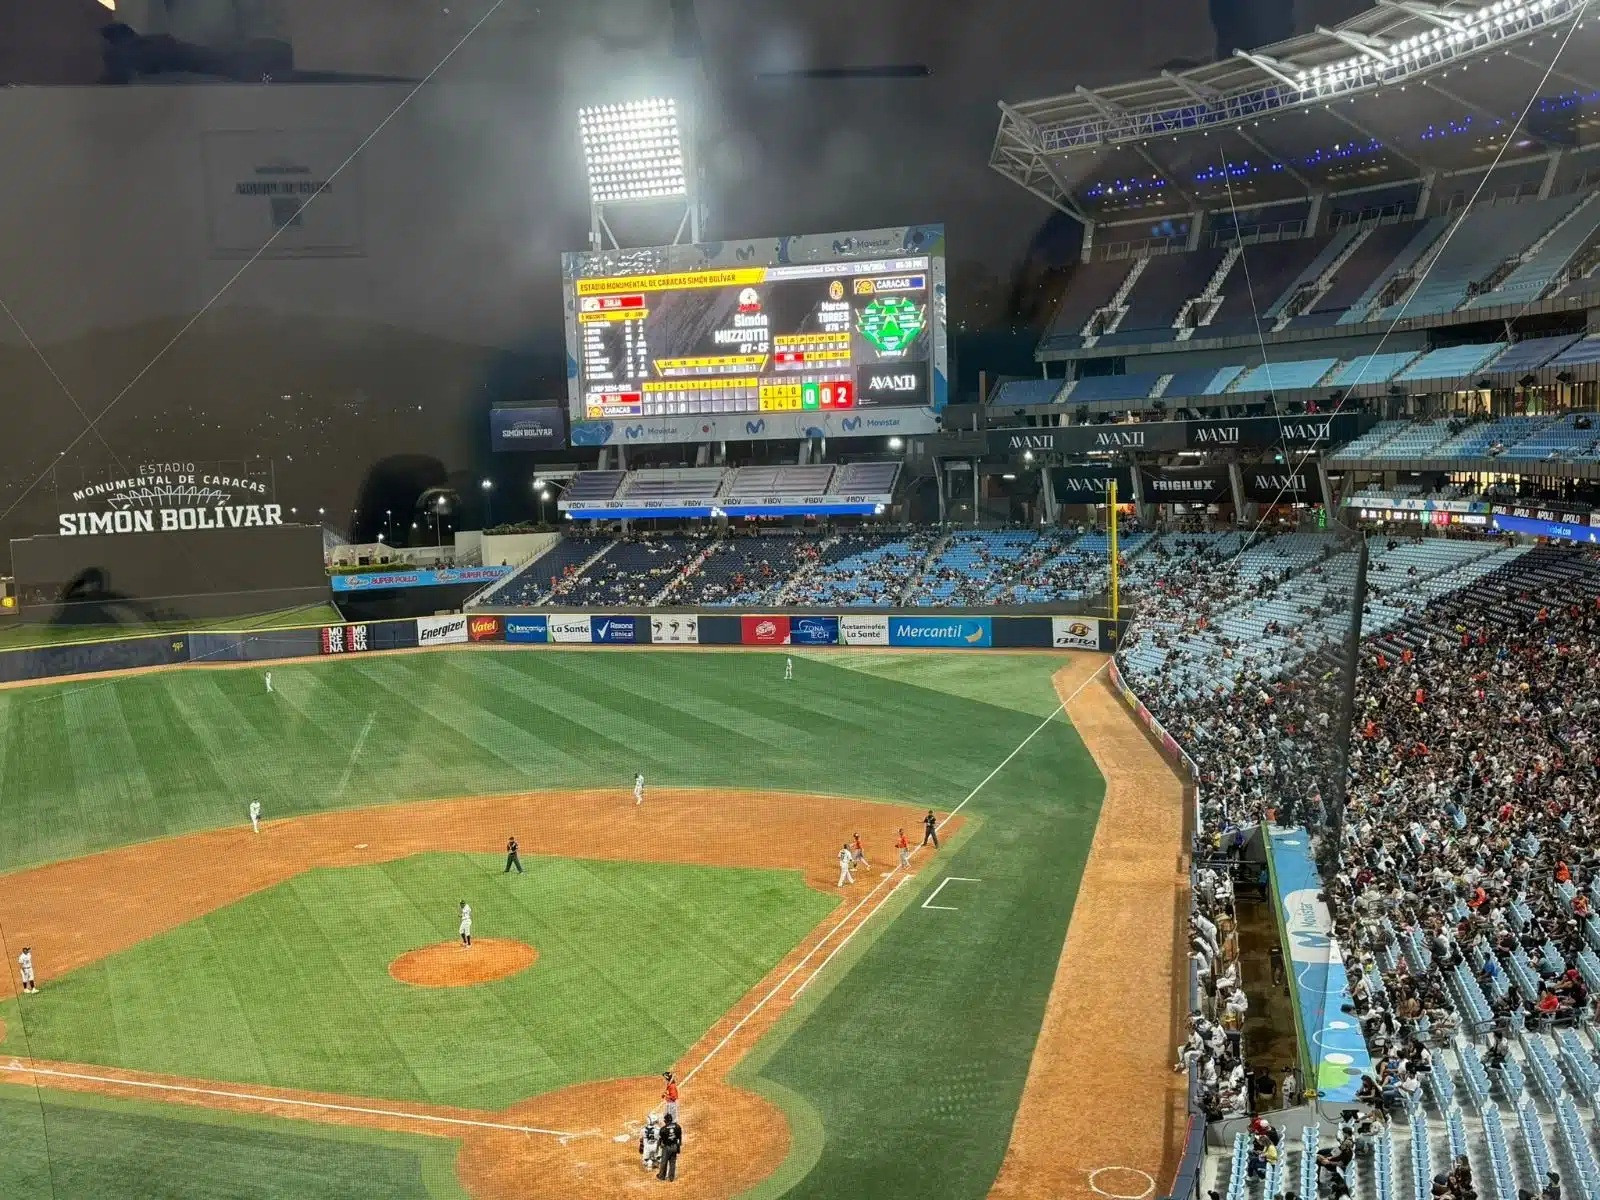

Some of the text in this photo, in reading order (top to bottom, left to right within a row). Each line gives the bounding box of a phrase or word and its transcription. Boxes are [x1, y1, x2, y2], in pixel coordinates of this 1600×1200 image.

[857, 238, 890, 249] Movistar
[580, 273, 736, 292] ESTADIO MONUMENTAL DE CARACAS SIMÓN BOLÍVAR
[876, 279, 910, 289] CARACAS
[734, 312, 768, 328] Simón
[714, 328, 768, 344] MUZZIOTTI
[758, 342, 769, 353] CF
[868, 374, 916, 390] AVANTI
[805, 387, 848, 404] 0 0 2
[604, 405, 631, 414] CARACAS
[866, 418, 900, 429] Movistar
[648, 426, 677, 436] Movistar
[1195, 427, 1239, 442] AVANTI
[1281, 423, 1330, 439] AVANTI
[1008, 435, 1054, 449] AVANTI
[1096, 431, 1145, 446] AVANTI
[139, 462, 195, 475] ESTADIO
[72, 474, 267, 501] MONUMENTAL DE CARACAS
[1152, 479, 1213, 491] FRIGILUX
[1254, 474, 1307, 490] AVANTI
[1492, 505, 1506, 515] APOLO
[1513, 507, 1530, 518] APOLO
[1537, 510, 1554, 521] APOLO
[58, 500, 283, 536] SIMÓN BOLÍVAR
[1562, 513, 1580, 524] APOLO
[370, 576, 394, 585] SUPER
[394, 575, 418, 584] POLLO
[459, 570, 481, 579] SUPER
[352, 625, 366, 634] MO
[420, 619, 466, 641] Energizer
[470, 619, 497, 633] Vatel
[551, 623, 590, 634] La Santé
[610, 621, 634, 630] Rexona
[804, 625, 825, 633] ZONA
[896, 624, 962, 638] Mercantil
[328, 627, 343, 636] MO
[846, 629, 881, 639] La Santé
[329, 635, 343, 644] RE
[353, 633, 367, 642] RE
[1056, 637, 1097, 646] BERA
[329, 643, 344, 653] NA
[353, 642, 367, 651] NA
[1300, 902, 1317, 928] Movistar
